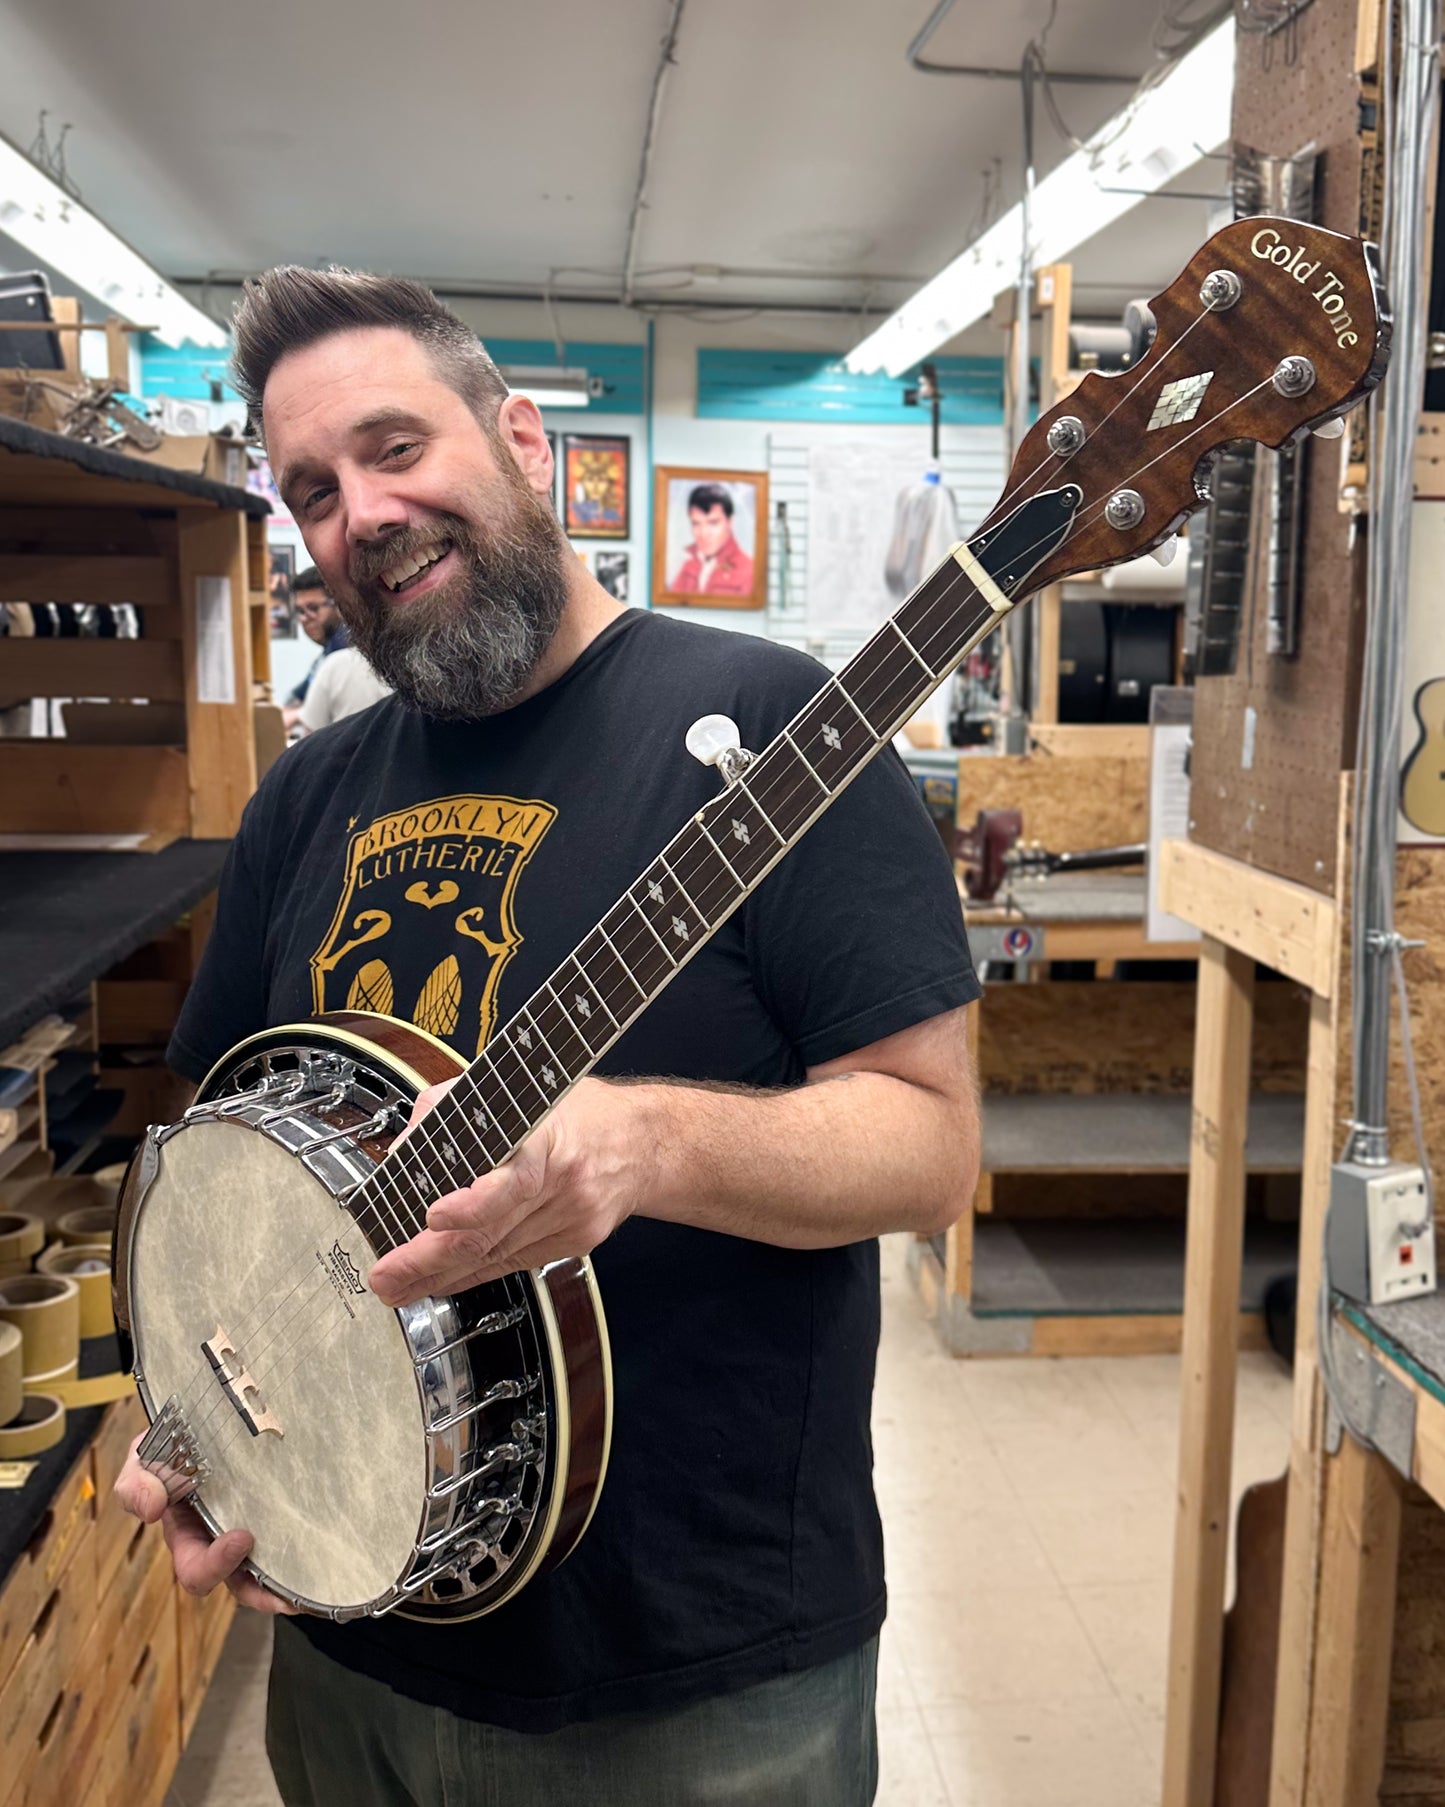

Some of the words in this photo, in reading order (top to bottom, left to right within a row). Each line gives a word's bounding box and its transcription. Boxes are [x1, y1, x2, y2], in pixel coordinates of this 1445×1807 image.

[1250, 228, 1322, 285] Gold
[1311, 271, 1359, 349] Tone
[361, 803, 540, 856] BROOKLYN
[358, 842, 515, 889] LUTHERIE
